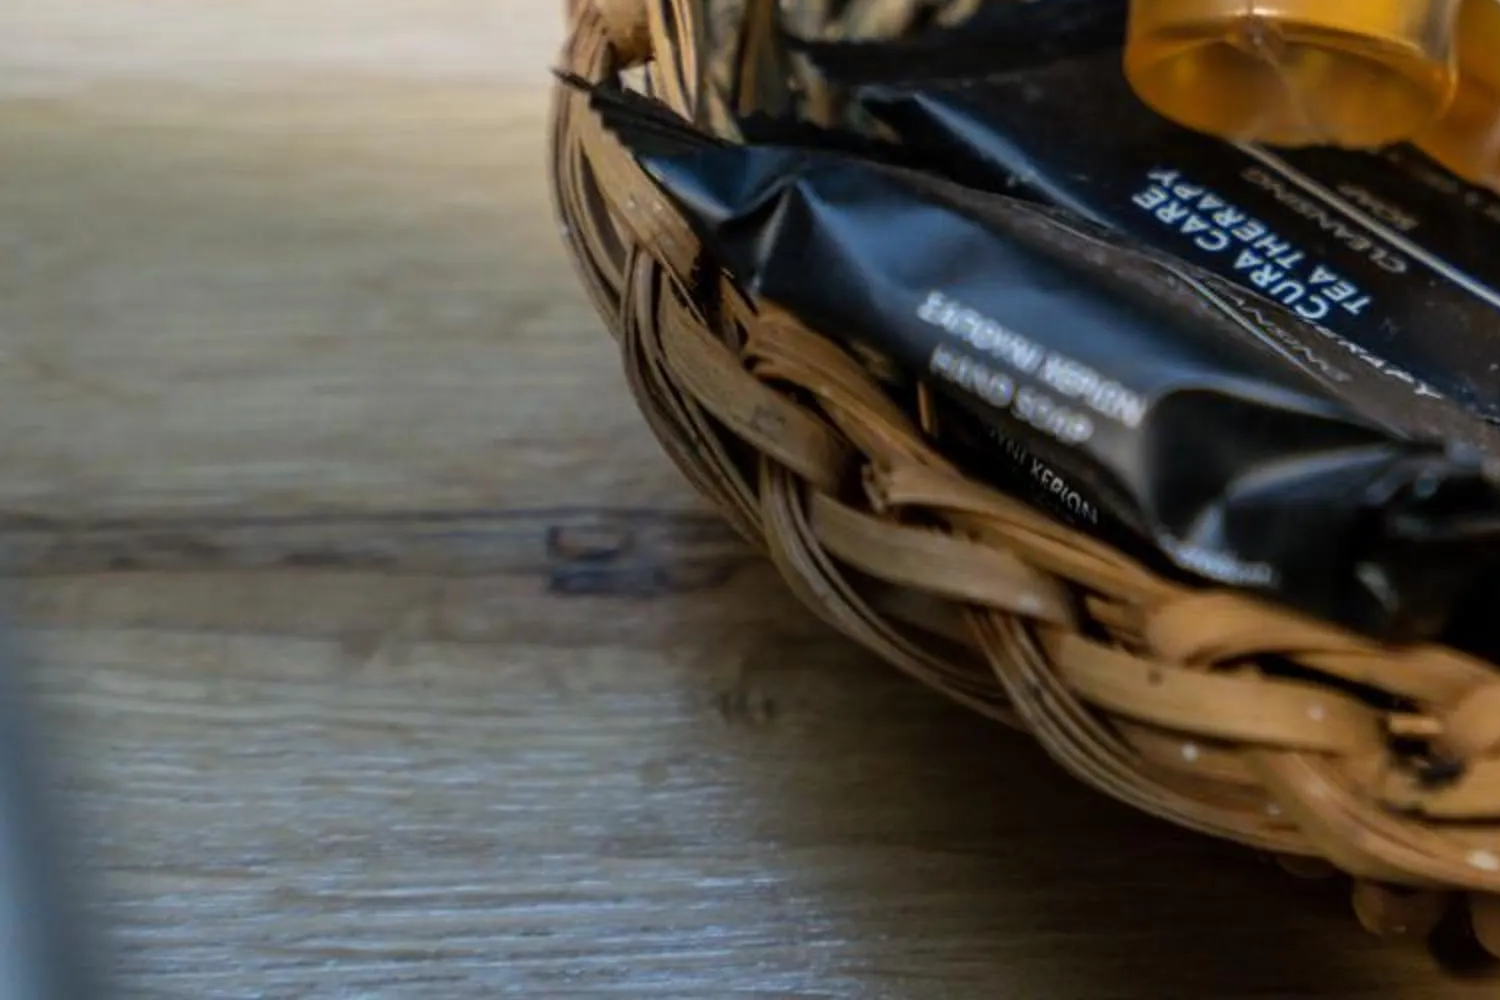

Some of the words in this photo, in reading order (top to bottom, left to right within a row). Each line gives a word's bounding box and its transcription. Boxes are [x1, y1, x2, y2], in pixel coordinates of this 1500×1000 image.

[1132, 184, 1229, 250] CARE
[1148, 165, 1304, 269] THERAPY
[1234, 250, 1328, 319] CURA
[1308, 264, 1372, 315] TEA
